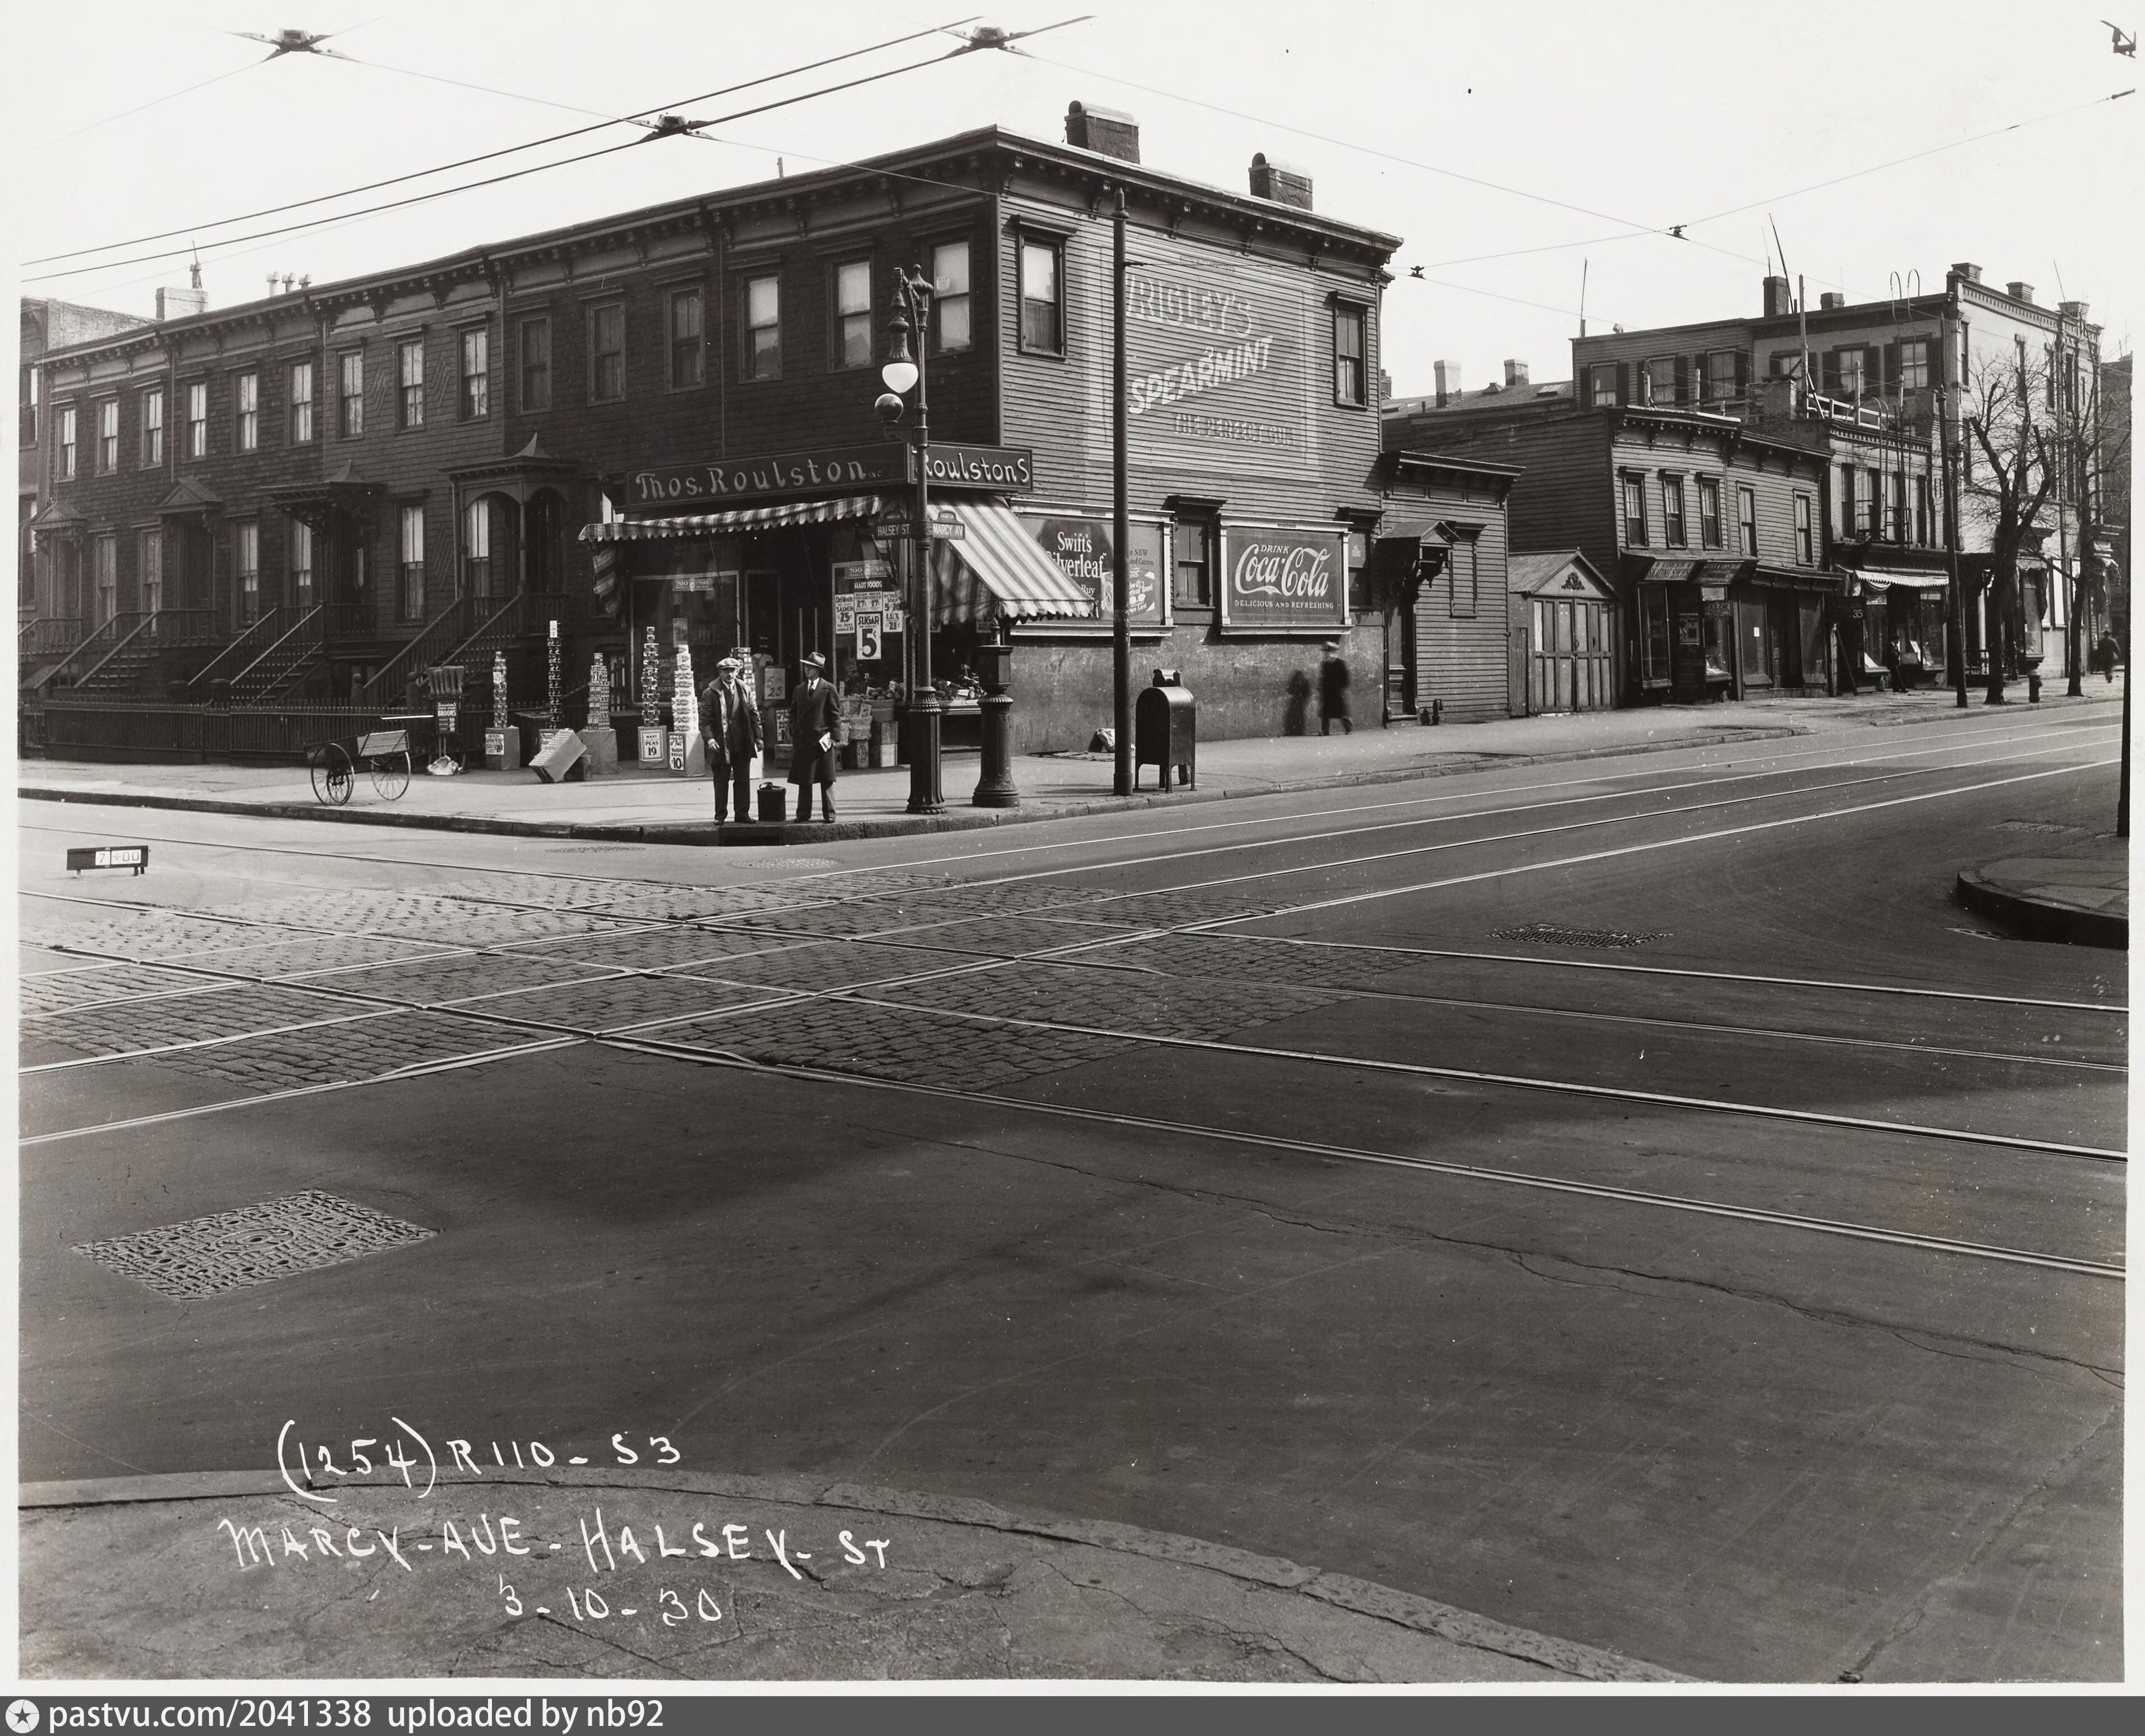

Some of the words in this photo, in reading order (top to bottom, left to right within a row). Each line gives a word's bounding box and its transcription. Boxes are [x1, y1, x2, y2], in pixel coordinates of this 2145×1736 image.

[1127, 335, 1274, 415] SPEARMINT
[1176, 413, 1200, 436] THE
[1206, 418, 1264, 444] PERFECT
[635, 473, 703, 500] Thos.
[707, 458, 867, 495] Roulston
[877, 524, 900, 536] HALSEY
[901, 523, 910, 535] ST
[932, 523, 952, 535] MARCY
[955, 525, 964, 536] AV
[1057, 531, 1093, 553] Swift's
[1260, 545, 1290, 554] DRINK
[1291, 601, 1334, 609] REFRESHING
[1852, 609, 1863, 619] 35
[858, 616, 880, 625] SUGAR
[648, 747, 657, 756] 19
[673, 757, 682, 769] 10
